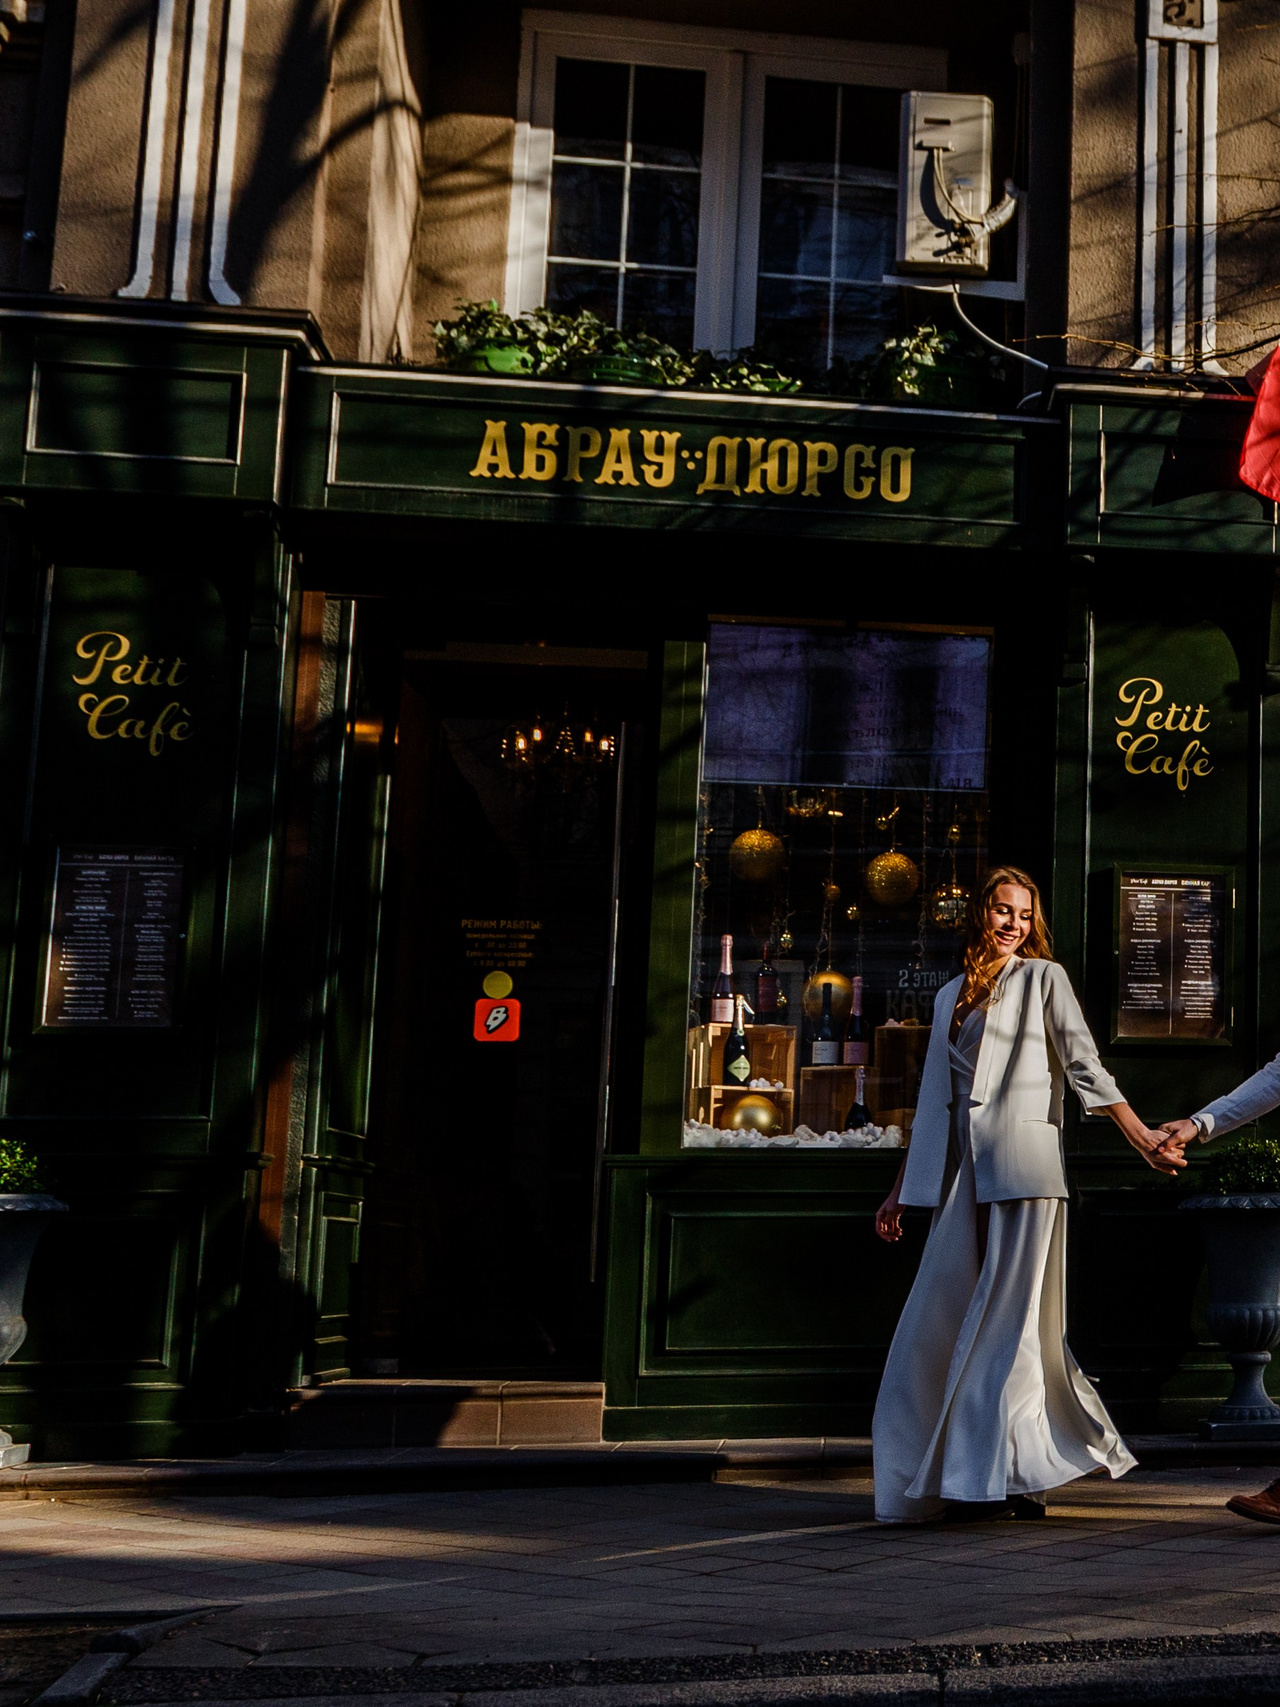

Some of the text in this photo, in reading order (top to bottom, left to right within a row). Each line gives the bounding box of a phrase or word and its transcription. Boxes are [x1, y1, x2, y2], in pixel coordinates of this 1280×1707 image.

[72, 631, 188, 686] Petit
[1115, 677, 1211, 732] Petit
[461, 919, 497, 929] РЕЖИМ
[898, 969, 949, 988] 2 ЭТАЖ
[886, 989, 937, 1020] КАФ
